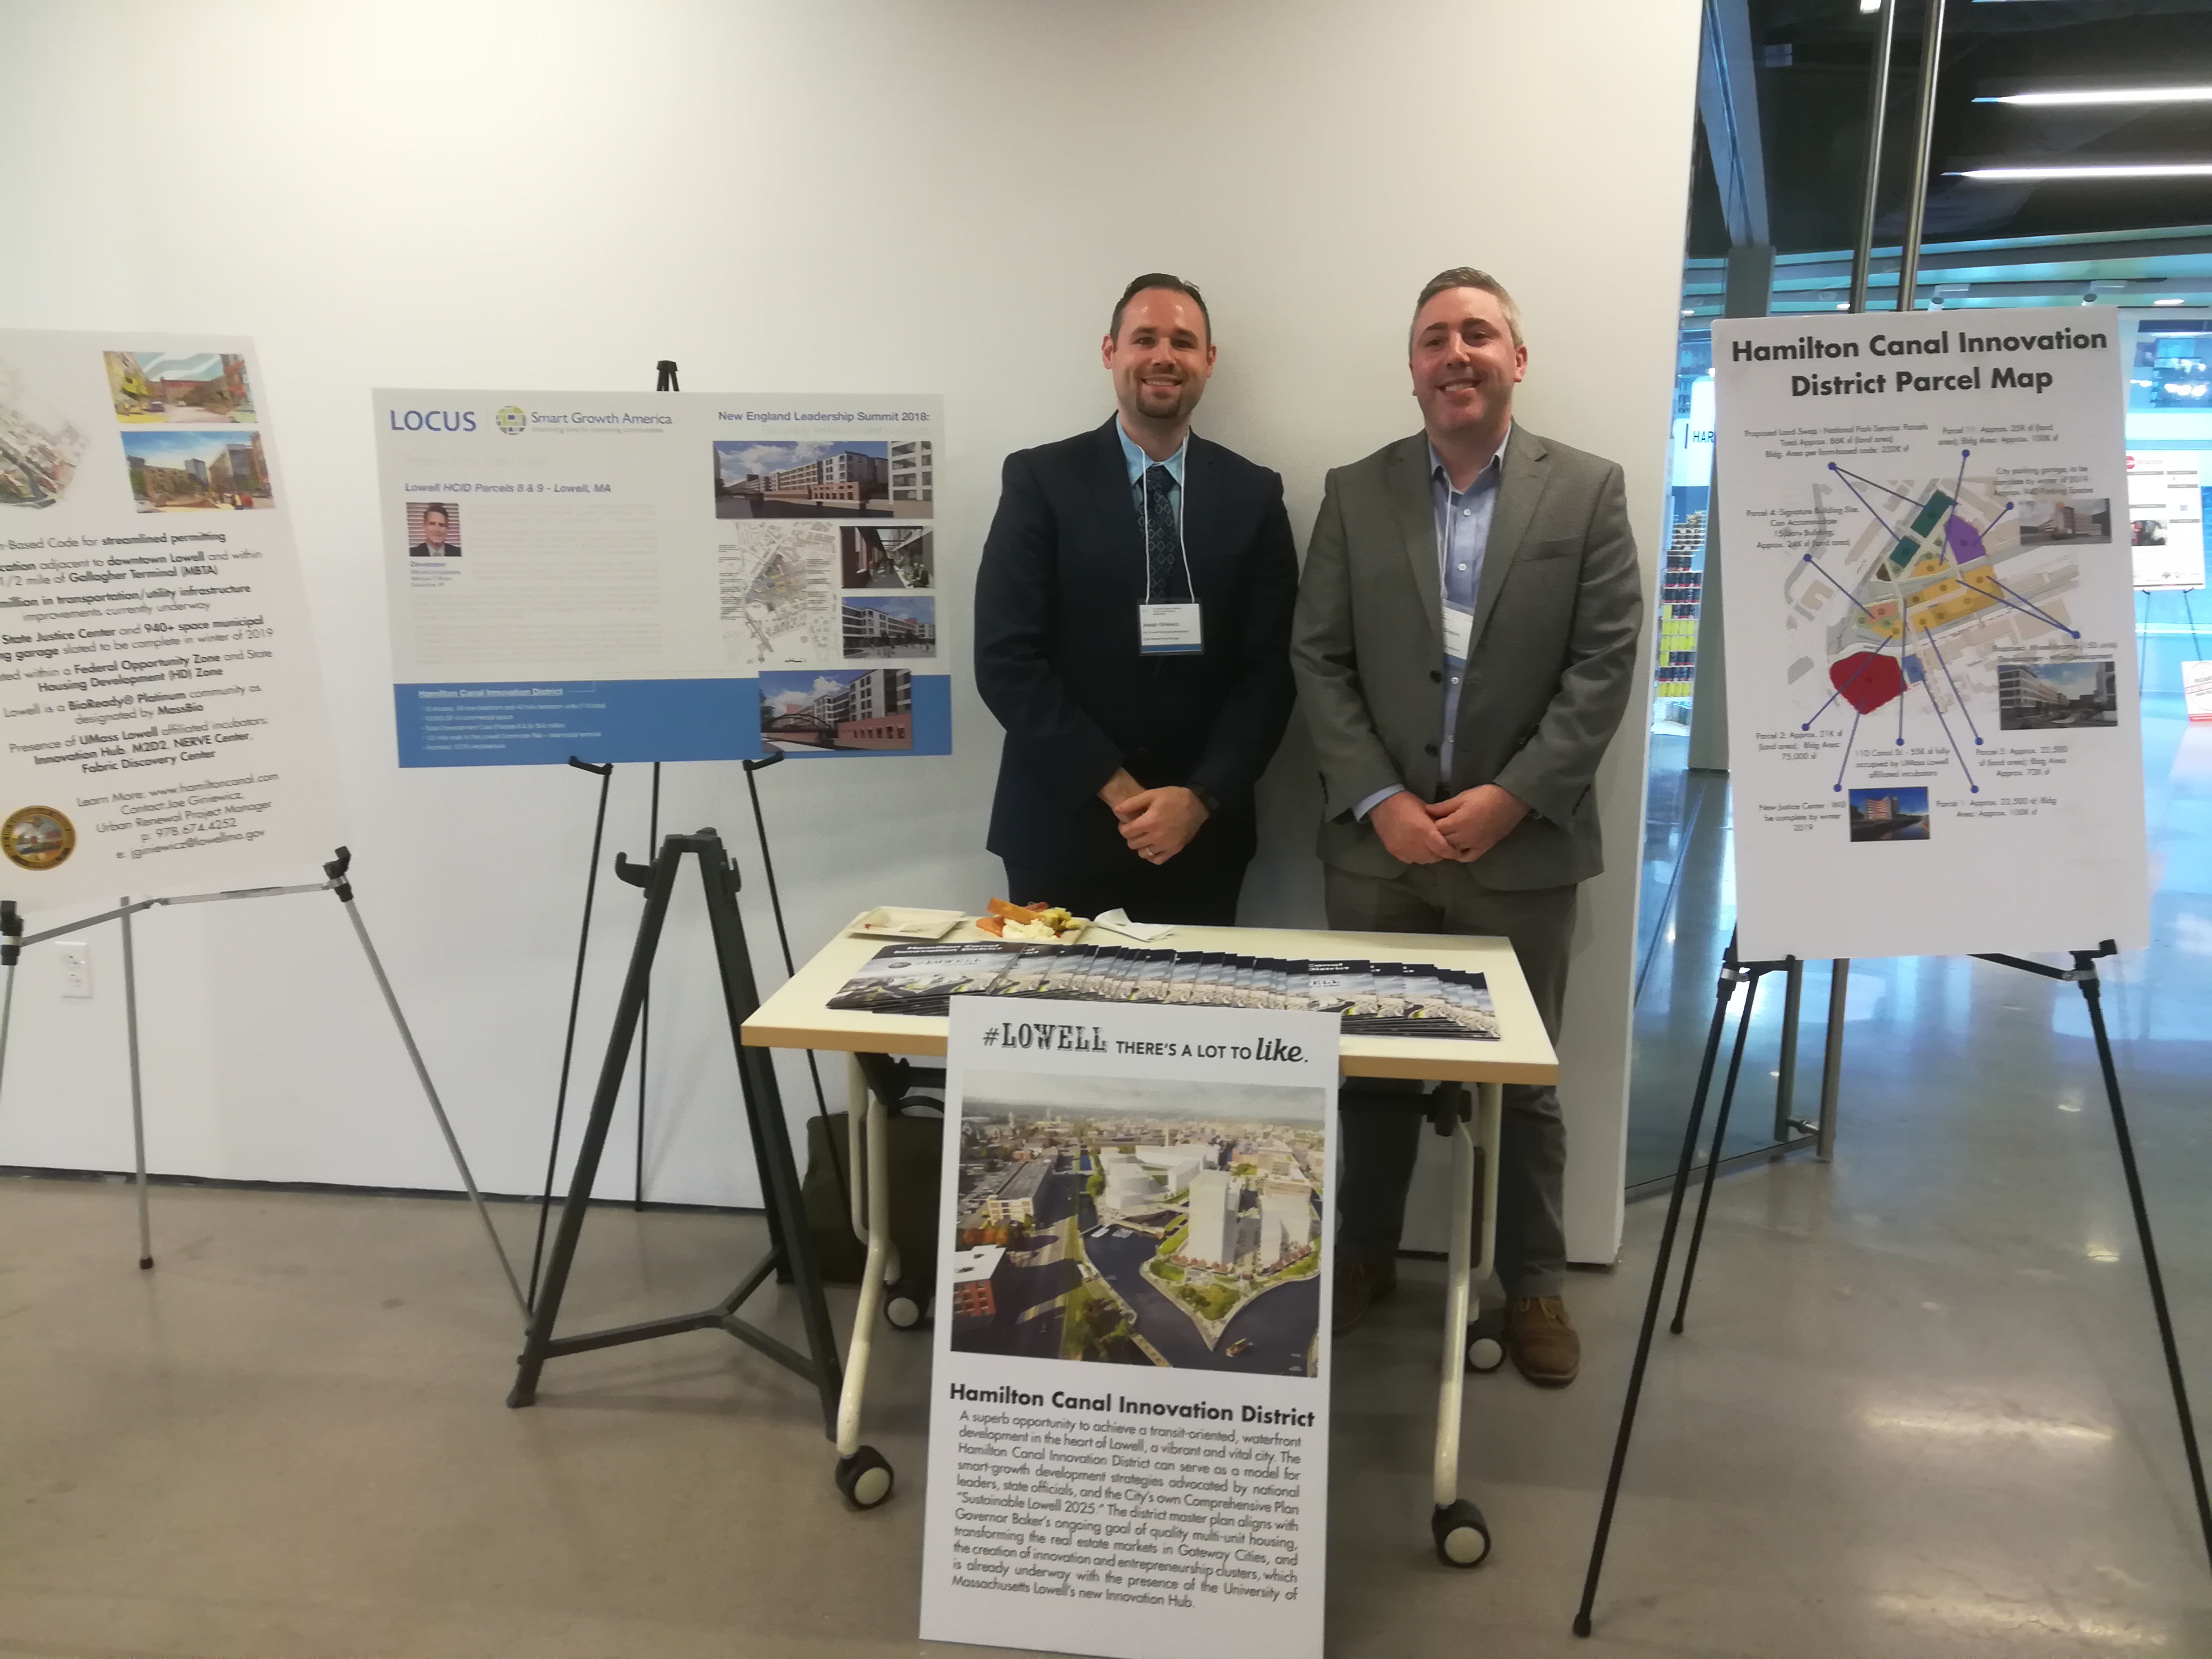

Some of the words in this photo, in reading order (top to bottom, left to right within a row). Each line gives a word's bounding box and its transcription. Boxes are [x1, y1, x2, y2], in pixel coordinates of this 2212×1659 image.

[1733, 336, 1859, 361] Hamilton
[1870, 331, 1949, 356] Canal
[1959, 327, 2107, 352] Innovation
[1792, 372, 1886, 396] District
[1896, 366, 1980, 391] Parcel
[1991, 367, 2053, 394] Map
[390, 410, 477, 431] LOCUS
[531, 412, 569, 424] Smart
[571, 412, 619, 424] Growth
[622, 413, 673, 424] America
[718, 411, 743, 421] New
[746, 411, 791, 423] England
[794, 411, 855, 423] Leadership
[857, 411, 900, 421] Summit
[405, 482, 440, 492] Lowell
[443, 483, 472, 492] HCID
[476, 483, 515, 492] Parcels
[516, 483, 525, 492] 8
[526, 483, 534, 492] &
[536, 484, 544, 492] 9
[594, 484, 612, 493] MA
[47, 536, 79, 548] Code
[81, 535, 98, 547] for
[102, 532, 168, 546] streamlined
[170, 531, 226, 545] permitting
[982, 1022, 1108, 1053] #LOWELL
[1115, 1040, 1177, 1056] THERE'S
[1181, 1044, 1192, 1057] A
[1197, 1045, 1226, 1059] LOT
[1230, 1046, 1252, 1060] TO
[1255, 1037, 1309, 1063] like.
[949, 1382, 1044, 1407] Hamilton
[1052, 1391, 1112, 1412] Canal
[1119, 1395, 1233, 1421] Innovation
[1241, 1404, 1315, 1427] District
[958, 1425, 1028, 1443] development
[1031, 1432, 1041, 1443] in
[1044, 1431, 1061, 1445] the
[1064, 1433, 1093, 1447] heart
[1095, 1435, 1107, 1448] of
[1109, 1437, 1147, 1453] Lowell,
[1150, 1444, 1159, 1453] a
[1161, 1441, 1201, 1456] vibrant
[1203, 1445, 1226, 1458] and
[1229, 1447, 1252, 1460] vital
[1255, 1450, 1277, 1466] city.
[1280, 1449, 1301, 1464] The
[959, 1410, 969, 1421] A
[972, 1411, 1010, 1425] superb
[1012, 1418, 1076, 1432] opportunity
[1079, 1421, 1090, 1431] to
[1092, 1419, 1137, 1434] achieve
[1138, 1426, 1147, 1435] a
[1150, 1425, 1239, 1444] transit-oriented,
[1243, 1432, 1302, 1447] waterfront
[958, 1442, 1007, 1457] Hamilton
[1012, 1447, 1045, 1460] Canal
[1049, 1449, 1108, 1465] Innovation
[1112, 1454, 1150, 1469] District
[1154, 1461, 1175, 1471] can
[1179, 1463, 1210, 1474] serve
[1213, 1466, 1227, 1475] as
[1231, 1467, 1240, 1476] a
[1244, 1466, 1279, 1479] model
[1283, 1467, 1301, 1481] for
[957, 1473, 1000, 1491] leaders,
[1003, 1481, 1029, 1492] state
[1031, 1479, 1077, 1497] officials,
[1079, 1485, 1102, 1498] and
[1104, 1486, 1122, 1500] the
[1124, 1488, 1154, 1505] City's
[1156, 1494, 1181, 1505] own
[1183, 1493, 1272, 1512] Comprehensive
[1274, 1501, 1299, 1515] Plan
[958, 1462, 1030, 1476] smart-growth
[1035, 1464, 1106, 1482] development
[1110, 1473, 1163, 1489] strategies
[1168, 1476, 1229, 1492] advocated
[1233, 1480, 1249, 1497] by
[1253, 1484, 1300, 1498] national
[1027, 1497, 1061, 1511] Lowell
[1107, 1503, 1127, 1517] The
[1129, 1505, 1167, 1520] district
[1169, 1511, 1207, 1524] master
[1210, 1511, 1235, 1528] plan
[1237, 1514, 1272, 1532] aligns
[1274, 1518, 1298, 1531] with
